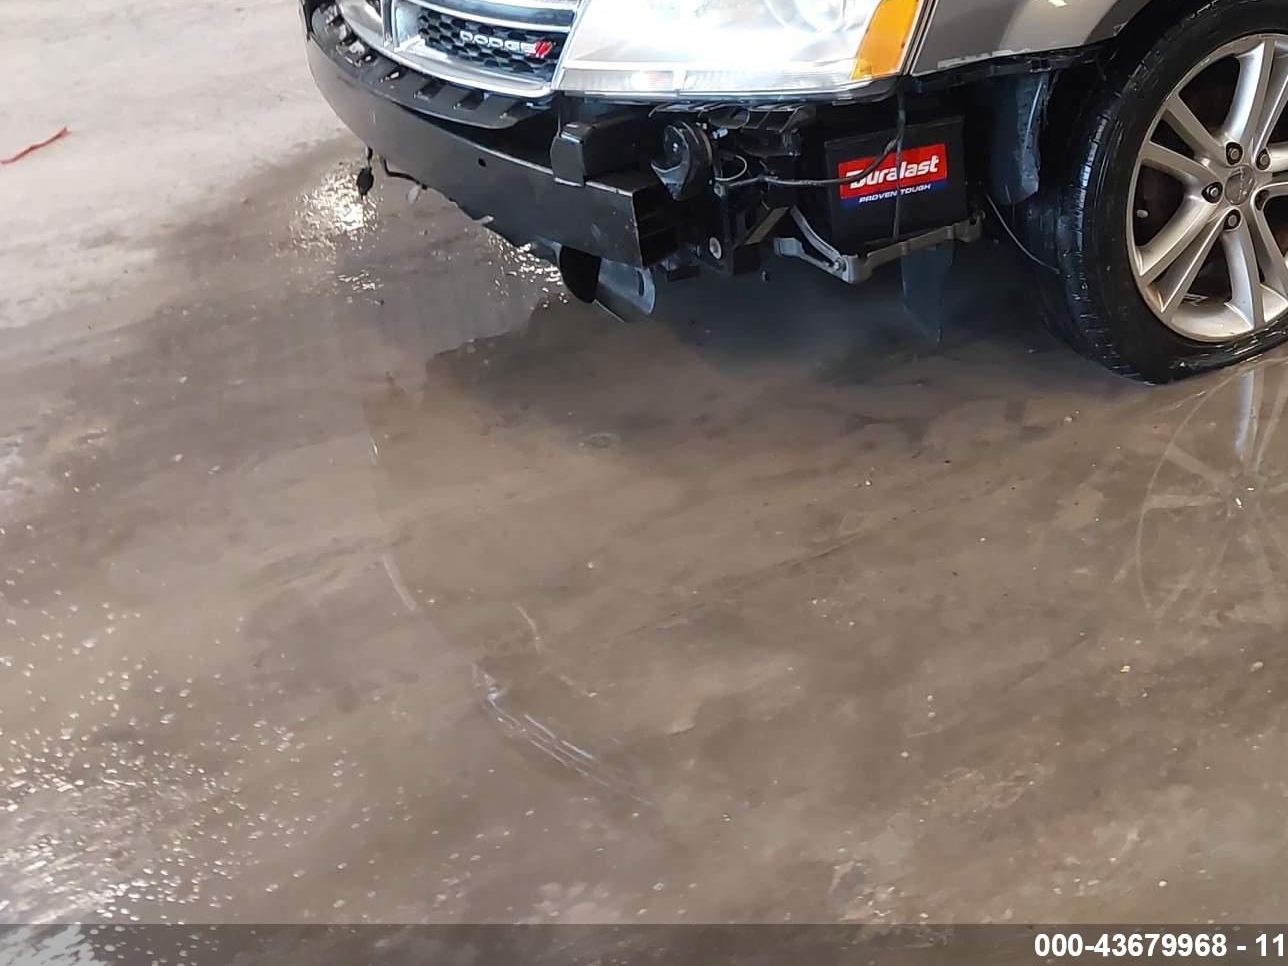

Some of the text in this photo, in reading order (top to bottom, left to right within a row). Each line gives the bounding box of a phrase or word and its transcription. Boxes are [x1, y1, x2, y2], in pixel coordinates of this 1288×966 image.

[460, 30, 537, 54] DODGE
[858, 183, 932, 203] PROVEN TOUGH
